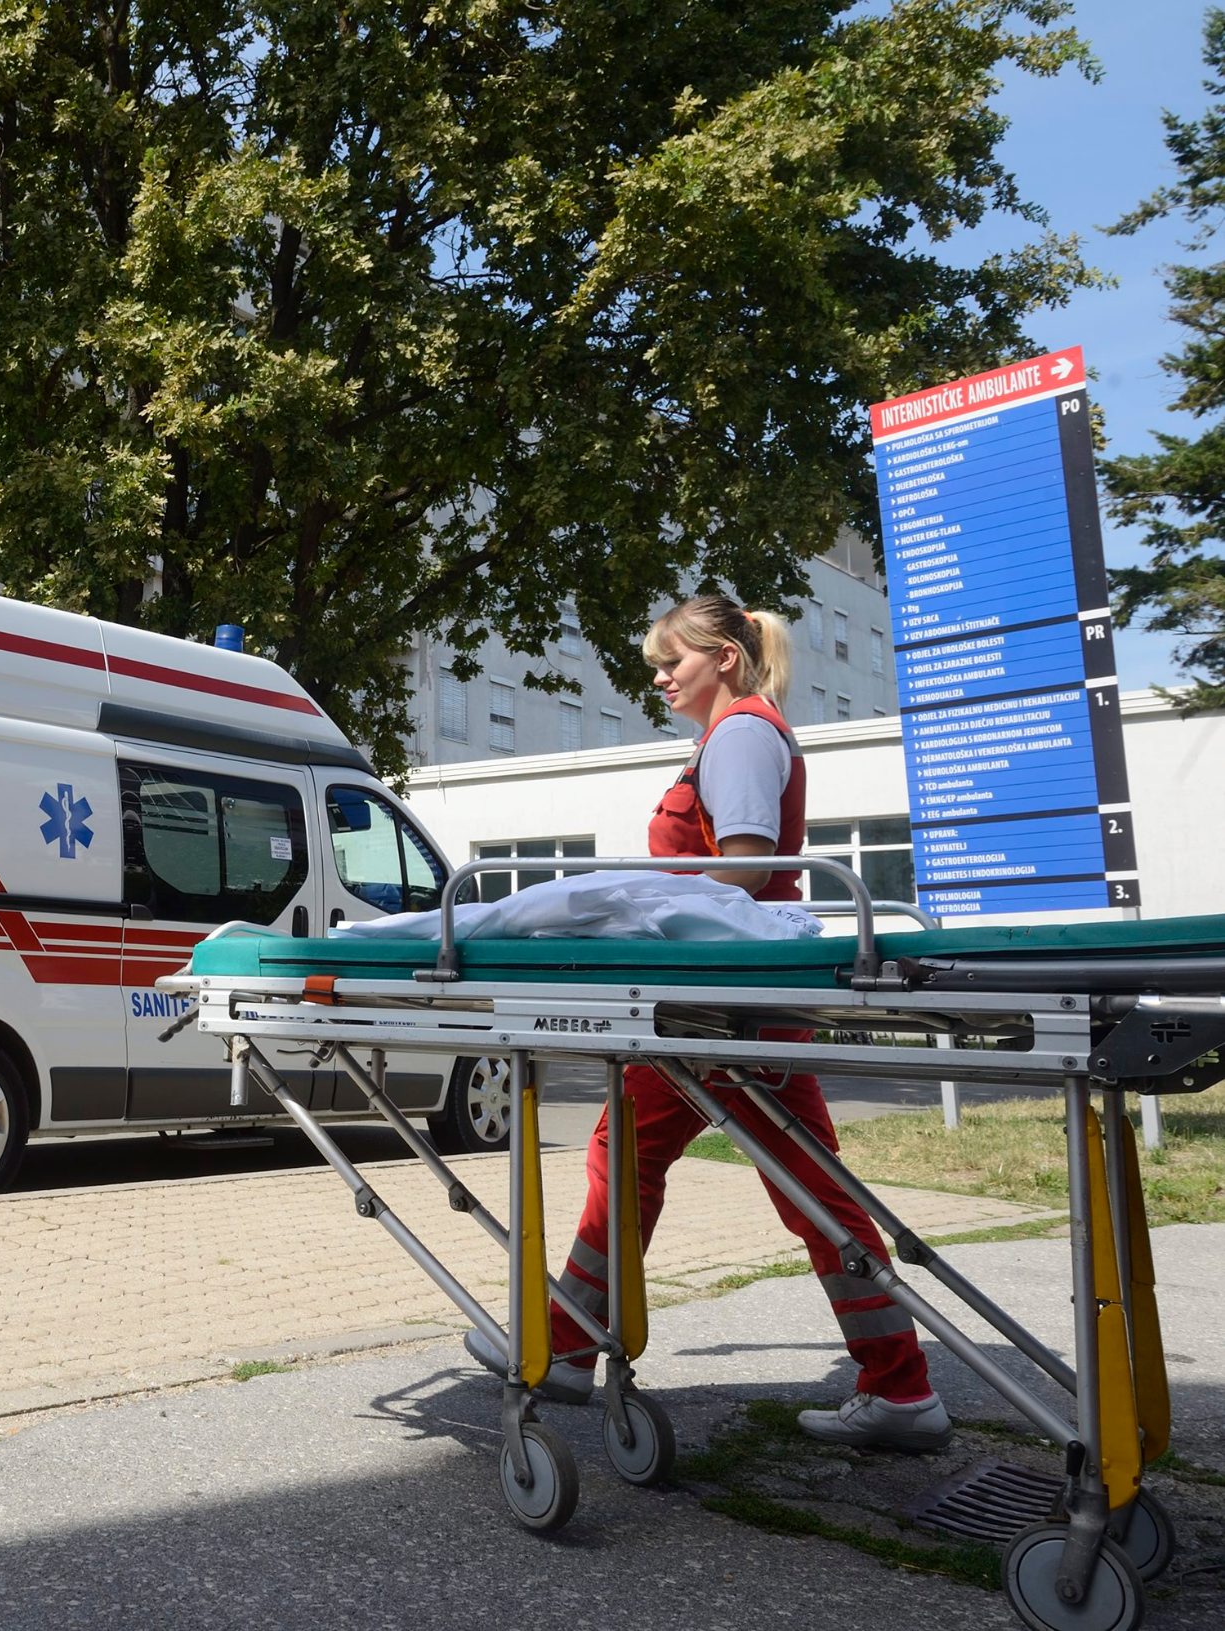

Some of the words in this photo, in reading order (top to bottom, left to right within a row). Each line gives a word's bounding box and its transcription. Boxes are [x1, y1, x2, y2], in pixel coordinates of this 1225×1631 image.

[881, 387, 964, 428] INTERNISTIČKE
[968, 364, 1041, 404] AMBULANTE
[1061, 398, 1080, 415] PO
[891, 433, 934, 451] PULMOLOŠKA
[934, 430, 943, 439] SA
[943, 415, 998, 437] SPIROMETRIJOM
[892, 446, 937, 464] KARDIOLOŠKA
[942, 439, 968, 451] EKG-om
[894, 453, 964, 477] GASTROENTEROLOŠKA
[896, 487, 938, 504] NEFROLOŠKA
[898, 507, 915, 518] OPĆA
[899, 515, 943, 531] ERGOMETRIJA
[900, 532, 925, 545] HOLTER
[925, 524, 961, 539] EKG-TLAKA
[902, 542, 946, 558] ENDOSKOPIJA
[906, 554, 958, 571] GASTROSKOPIJA
[908, 567, 960, 585] KOLONOSKOPIJA
[909, 581, 963, 598] BRONHOSKOPIJA
[907, 605, 919, 613] Rtg
[908, 617, 922, 626] UZV
[922, 614, 939, 624] SRCA
[909, 630, 923, 640] UZV
[923, 624, 961, 638] ABDOMENA
[964, 616, 1000, 630] ŠTITNJAČE
[1085, 624, 1105, 640] PR
[911, 649, 932, 659] ODJEL
[932, 647, 941, 656] ZA
[941, 641, 976, 654] UROLOŠKE
[976, 636, 1004, 648] BOLESTI
[913, 663, 933, 674] ODJEL
[933, 662, 942, 670] ZA
[942, 656, 973, 669] ZARAZNE
[973, 652, 1001, 664] BOLESTI
[914, 673, 963, 688] INFEKTOLOŠKA
[962, 667, 1005, 681] AMBULANTA
[916, 689, 964, 702] HEMODIJALIZA
[1095, 692, 1109, 706] 1.
[917, 712, 938, 721] ODJEL
[938, 710, 947, 719] ZA
[947, 705, 983, 717] FIZIKALNU
[983, 700, 1018, 712] MEDICINU
[1022, 691, 1079, 707] REHABILITACIJU
[919, 723, 960, 735] AMBULANTA
[960, 721, 967, 730] ZA
[969, 717, 994, 729] DJEČJU
[994, 710, 1050, 725] REHABILITACIJU
[920, 736, 968, 749] KARDIOLOGIJA
[973, 729, 1023, 742] KORONARNOM
[1023, 723, 1062, 736] JEDINICOM
[921, 749, 974, 763] DERMATOLOŠKA
[977, 742, 1027, 756] VENEROLOŠKA
[1027, 737, 1072, 750] AMBULANTA
[923, 764, 966, 777] NEUROLOŠKA
[966, 759, 1009, 772] AMBULANTA
[924, 782, 938, 790] TCD
[937, 779, 973, 790] ambulanta
[956, 791, 993, 801] ambulanta
[927, 810, 940, 819] EEG
[941, 807, 978, 817] ambulanta
[929, 829, 958, 839] UPRAVA:
[1108, 819, 1123, 834] 2.
[930, 842, 967, 852] RAVNATELJ
[931, 853, 1005, 866] GASTROENTEROLOGIJA
[932, 870, 968, 880] DIJABETES
[971, 865, 1035, 878] ENDOKRINOLOGIJA
[934, 891, 981, 901] PULMOLOGIJA
[1115, 884, 1129, 899] 3.
[936, 903, 980, 913] NEFROLOGIJA
[131, 991, 198, 1018] SANITE
[533, 1017, 592, 1033] MEBER
